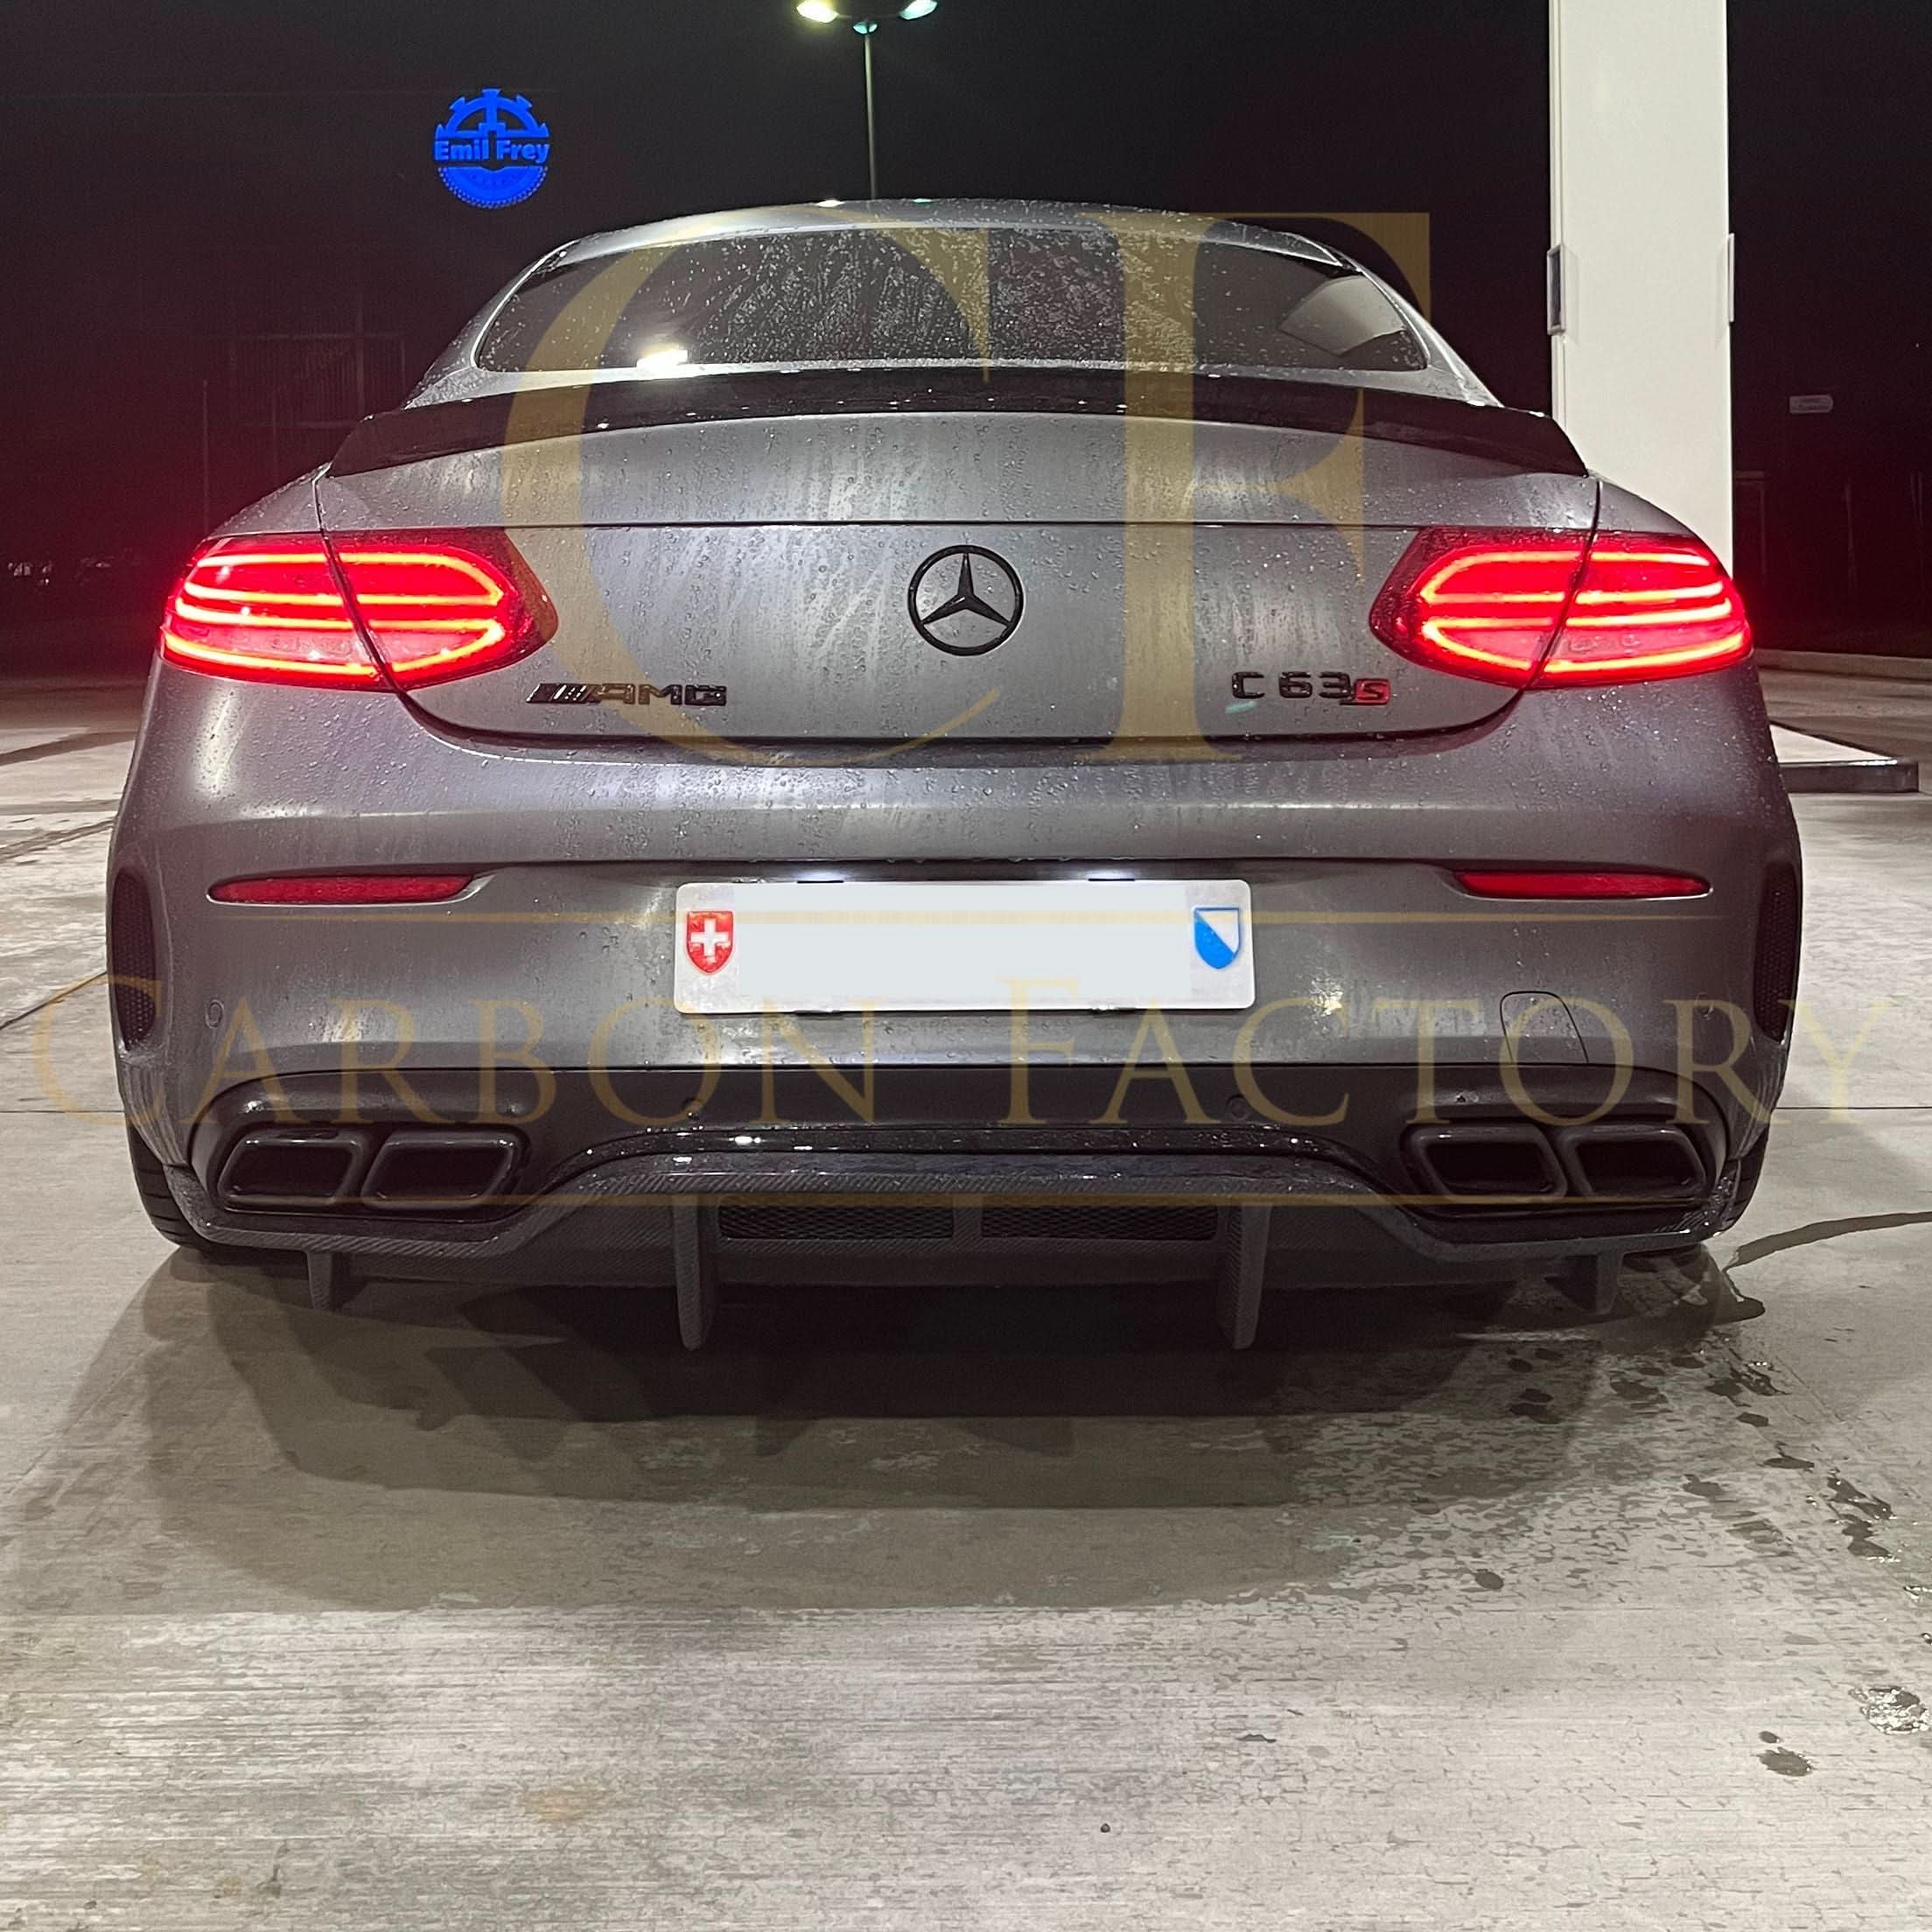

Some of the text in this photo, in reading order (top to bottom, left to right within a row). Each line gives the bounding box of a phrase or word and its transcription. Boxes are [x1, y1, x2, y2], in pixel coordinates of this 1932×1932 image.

[434, 139, 550, 164] Emil Frey
[595, 682, 727, 706] AMG
[1231, 671, 1265, 699] C
